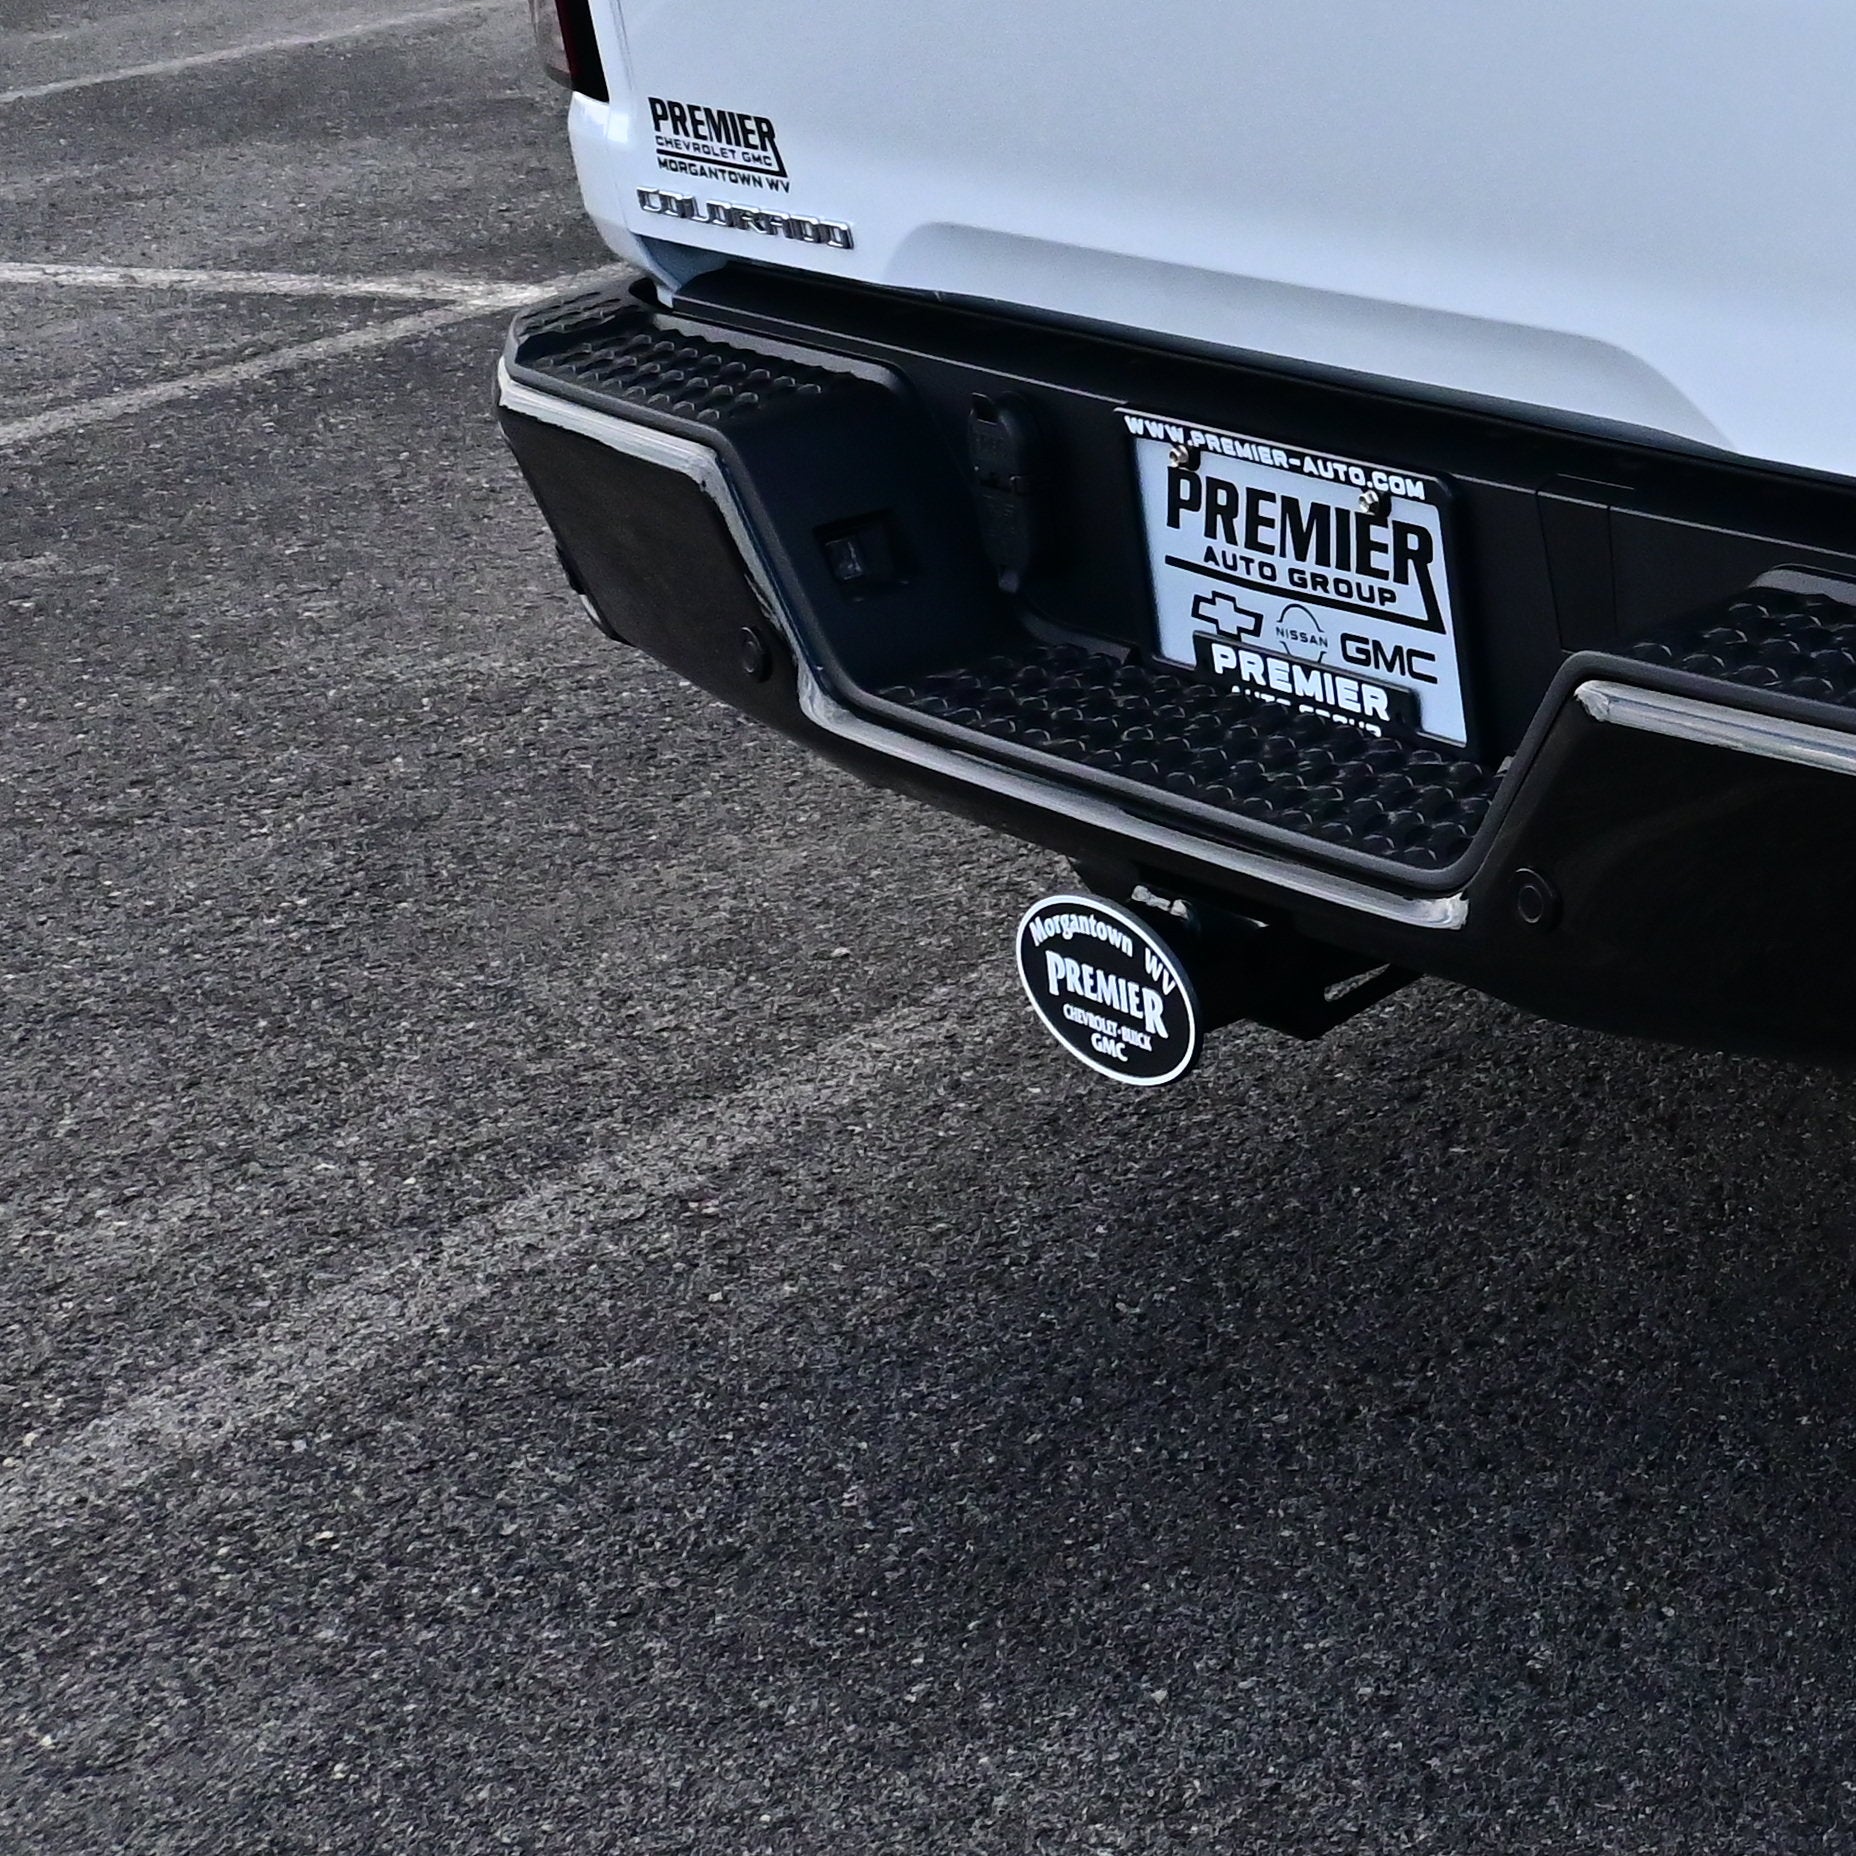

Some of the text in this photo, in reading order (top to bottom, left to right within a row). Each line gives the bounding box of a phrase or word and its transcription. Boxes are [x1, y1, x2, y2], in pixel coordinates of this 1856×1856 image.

[648, 96, 777, 154] PREMIER
[655, 135, 773, 167] CHEVROLET GMC
[657, 156, 791, 194] MORGANTOWN WV
[636, 185, 855, 251] COLORADO
[1124, 415, 1426, 501] WWW.PREMIER-AUTO.COM
[1166, 465, 1434, 586] PREMIER
[1203, 546, 1397, 608] AUTO GROUP
[1211, 642, 1391, 722] PREMIER
[1276, 625, 1439, 685] NISSAN GMC
[1028, 913, 1178, 996] Morgantown WV
[1045, 950, 1169, 1039] PREMIER
[1091, 1033, 1129, 1062] GMC
